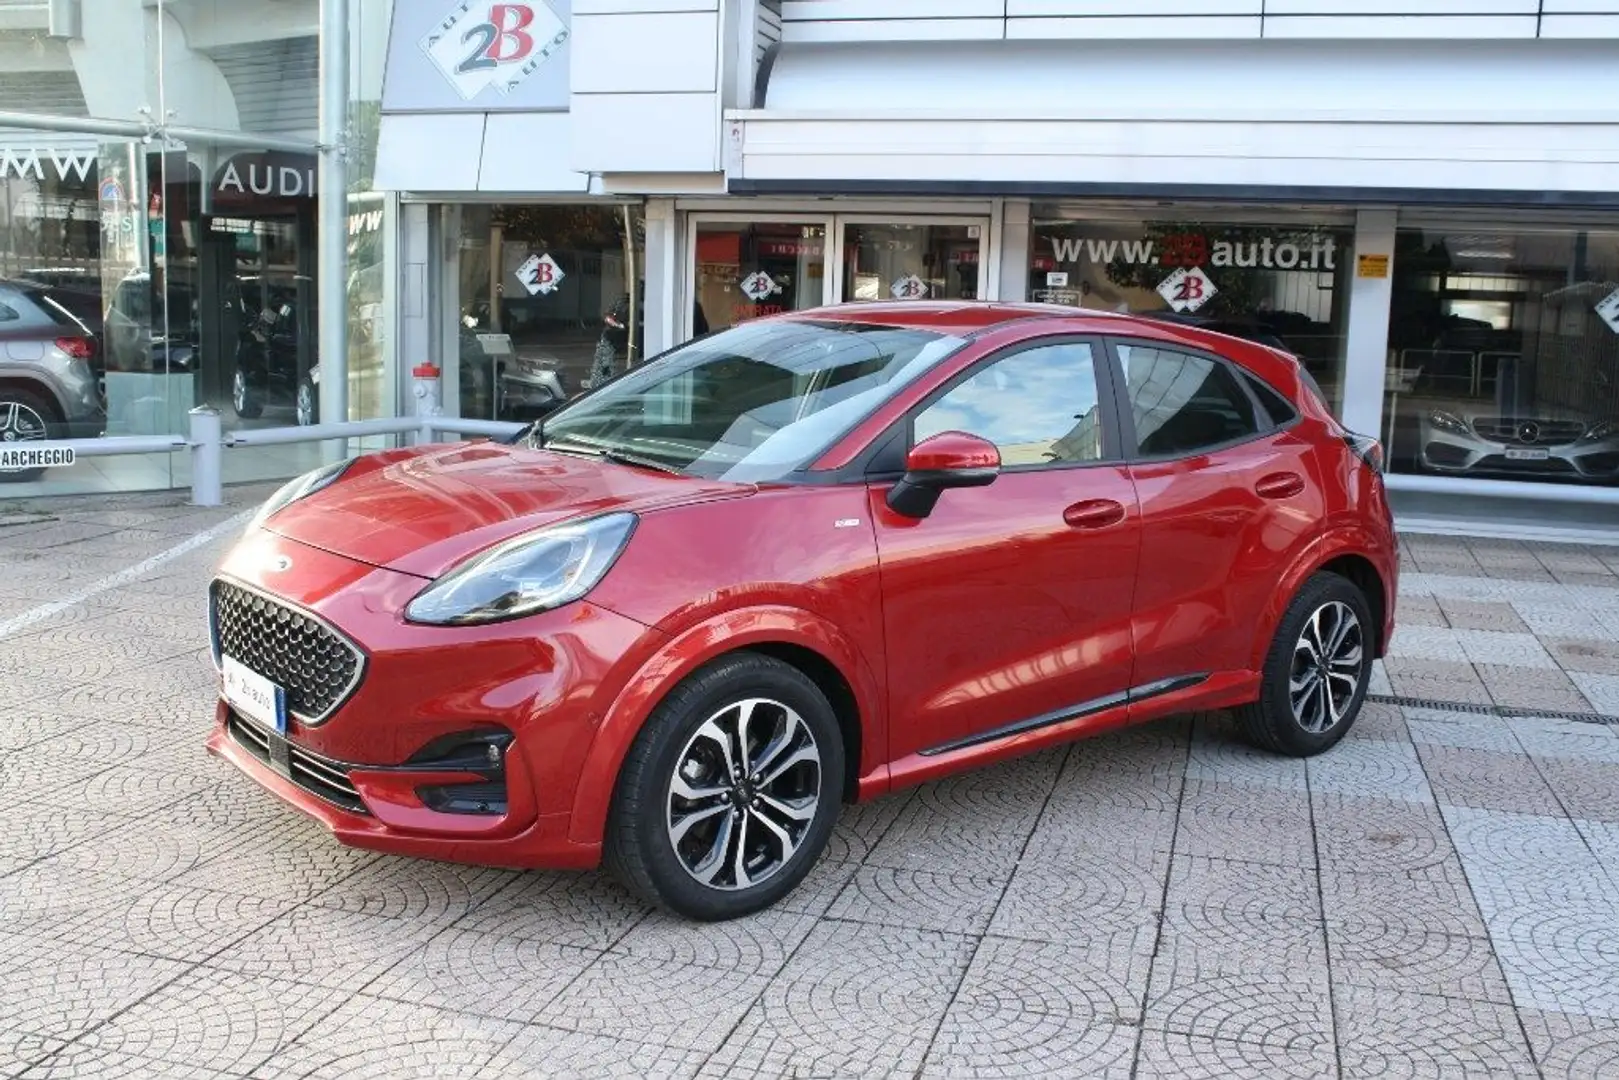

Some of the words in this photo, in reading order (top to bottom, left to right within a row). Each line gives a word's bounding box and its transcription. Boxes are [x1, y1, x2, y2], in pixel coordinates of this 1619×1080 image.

[428, 2, 470, 48] AUT
[456, 4, 534, 74] 2B
[218, 162, 314, 197] AUDI
[529, 263, 552, 284] 2B
[749, 277, 768, 293] 2B
[900, 280, 920, 297] 2B
[1173, 276, 1203, 300] 2B
[2, 448, 74, 466] ARCHEGGIO
